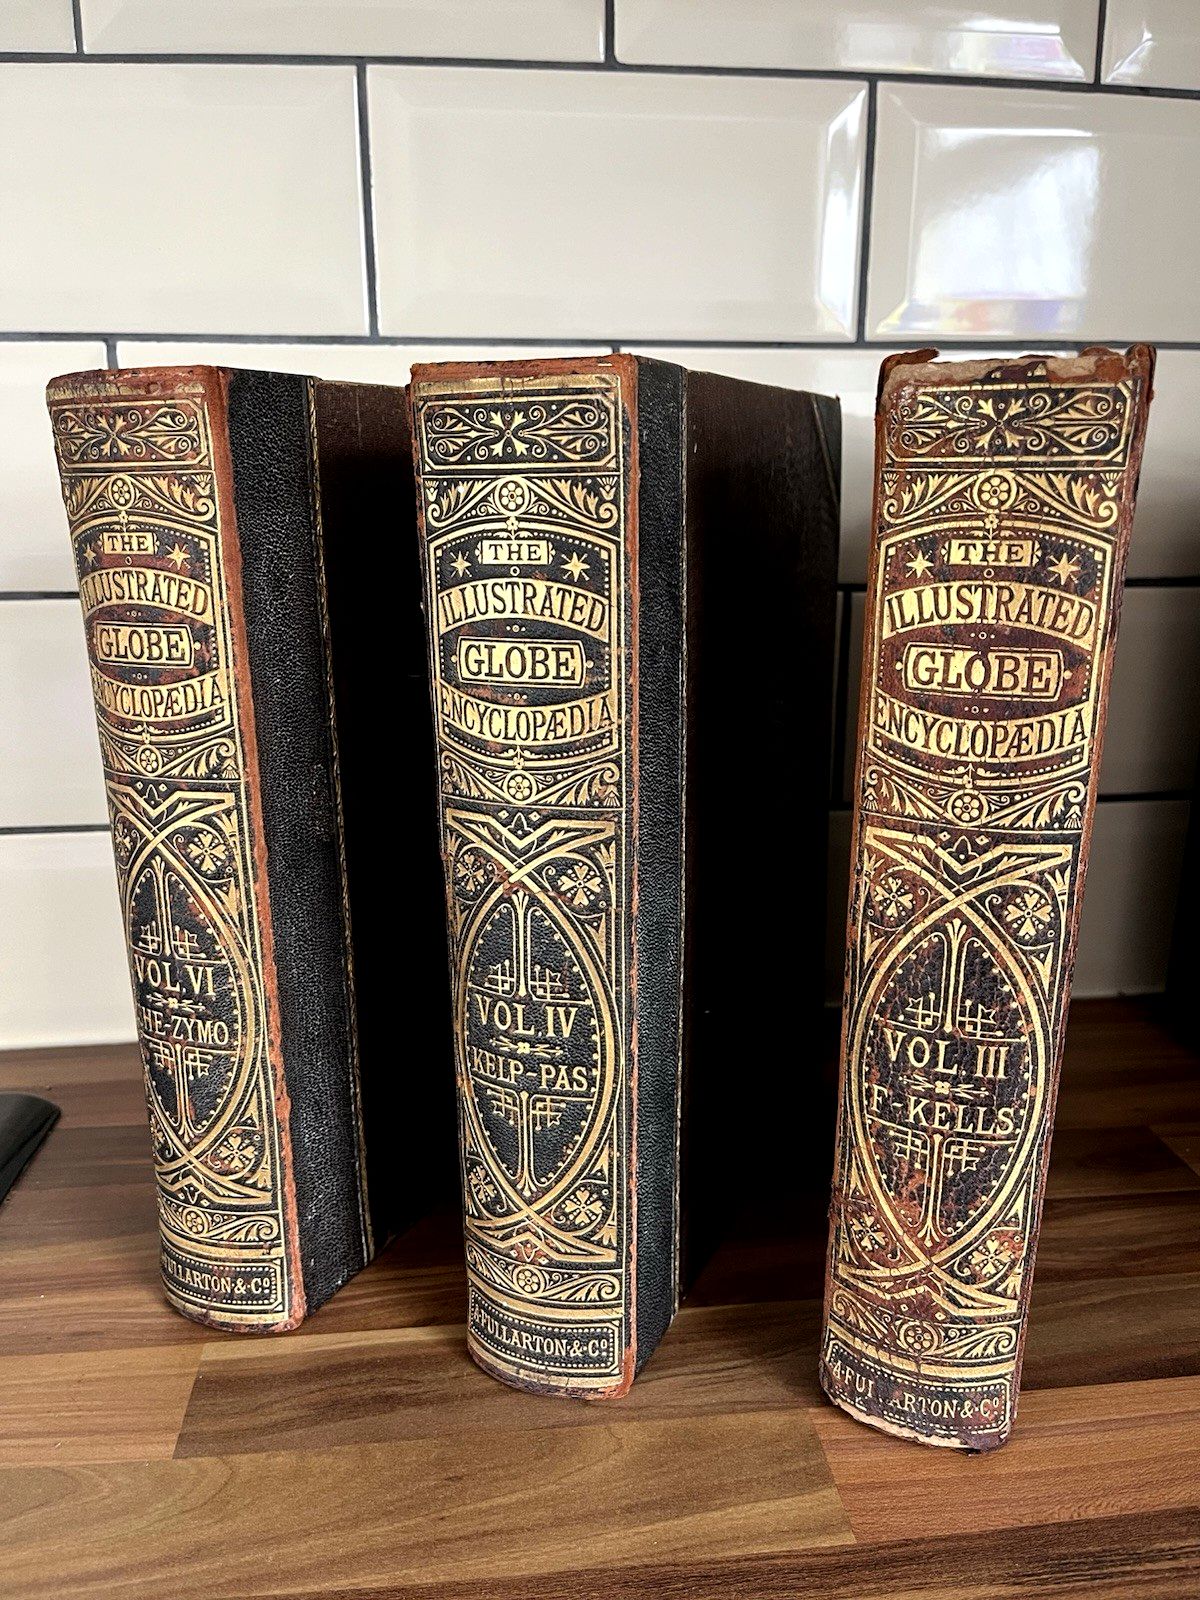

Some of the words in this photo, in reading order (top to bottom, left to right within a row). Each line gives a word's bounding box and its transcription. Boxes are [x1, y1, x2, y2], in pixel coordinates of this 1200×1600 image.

[108, 535, 147, 551] THE
[489, 544, 541, 561] THE
[958, 543, 1024, 562] THE
[81, 570, 208, 616] ILLUSTRATED
[440, 581, 606, 632] ILLUSTRATED
[886, 584, 1094, 639] ILLUSTRATED
[100, 628, 185, 661] GLOBE
[465, 644, 576, 680] GLOBE
[912, 651, 1051, 693] GLOBE
[186, 965, 216, 996] VI
[138, 1005, 229, 1045] HE-ZYMO
[546, 1006, 578, 1037] IV
[974, 1045, 1009, 1079] III
